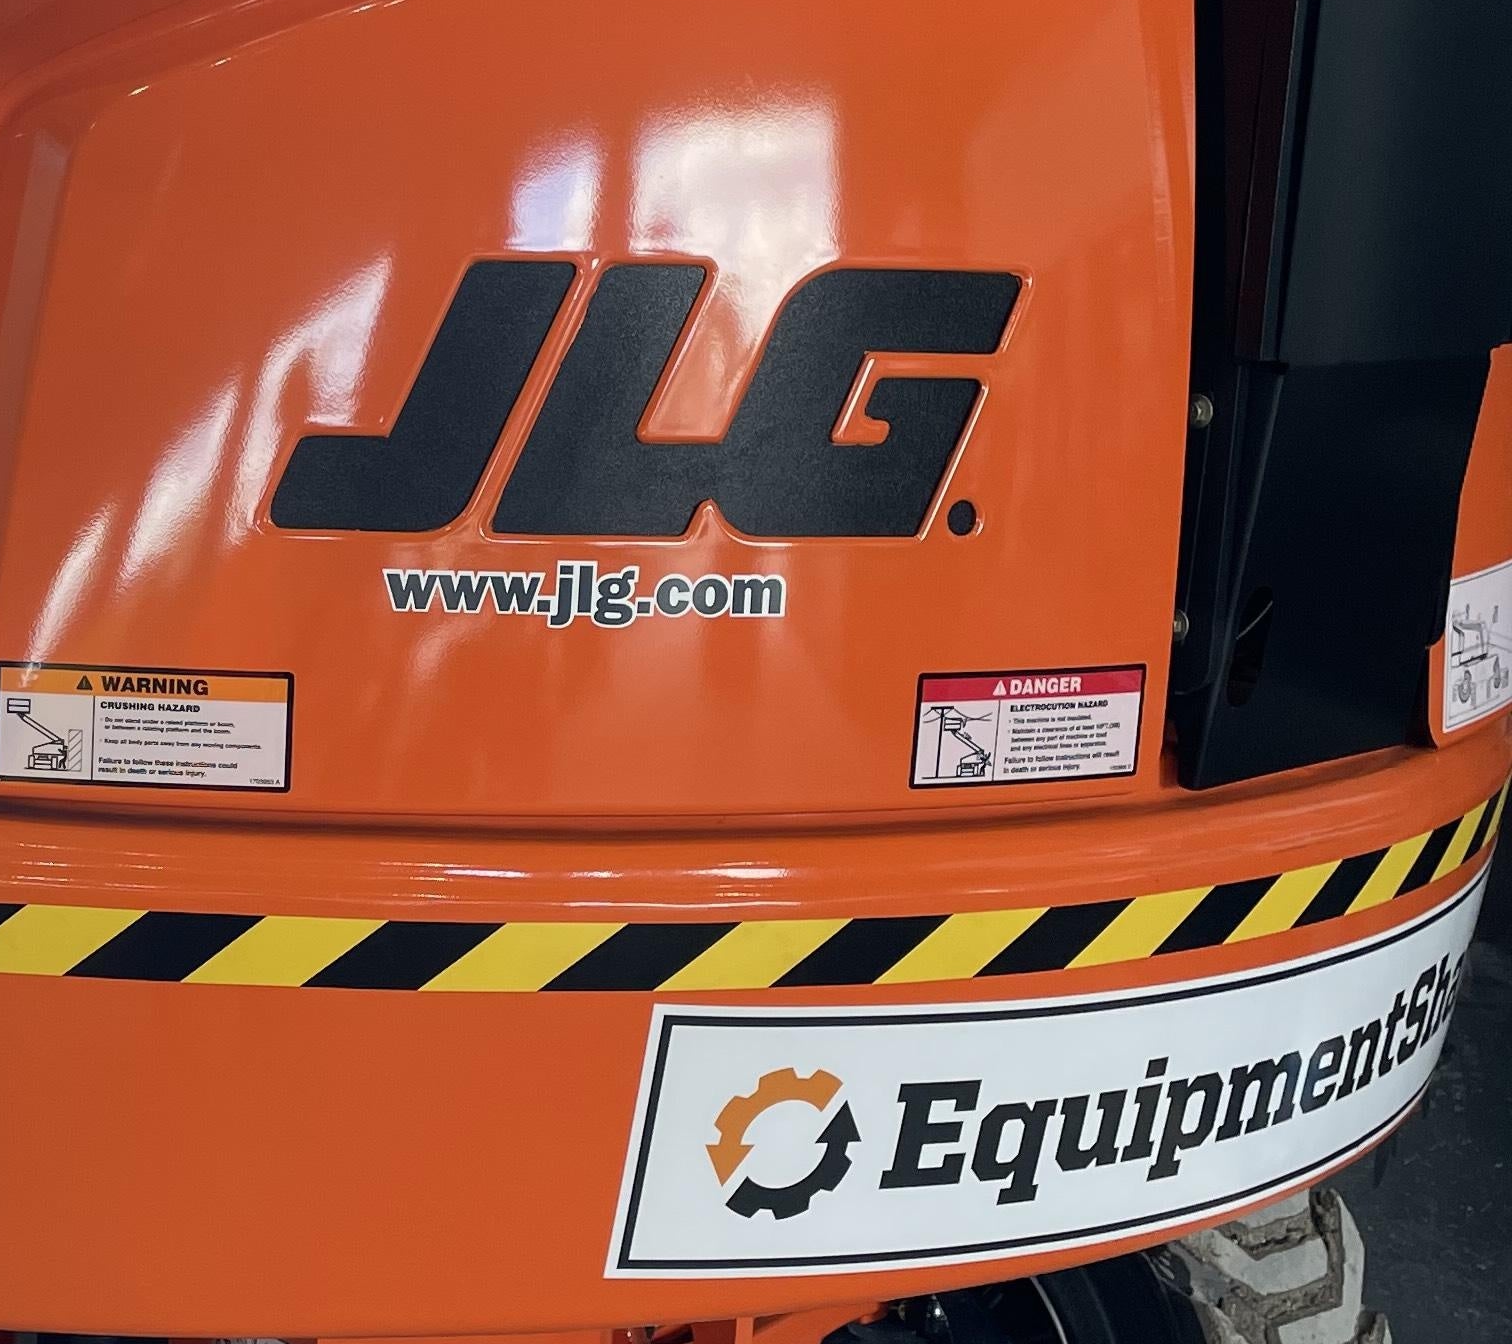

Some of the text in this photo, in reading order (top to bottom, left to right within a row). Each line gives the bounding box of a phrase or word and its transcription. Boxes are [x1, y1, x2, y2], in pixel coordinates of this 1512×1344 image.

[384, 561, 786, 627] www.jlg.com
[101, 675, 209, 696] WARNING
[1009, 676, 1082, 696] DANGER
[100, 701, 201, 713] CRUSHING HAZARD
[1010, 702, 1076, 712] ELECTROCUTION
